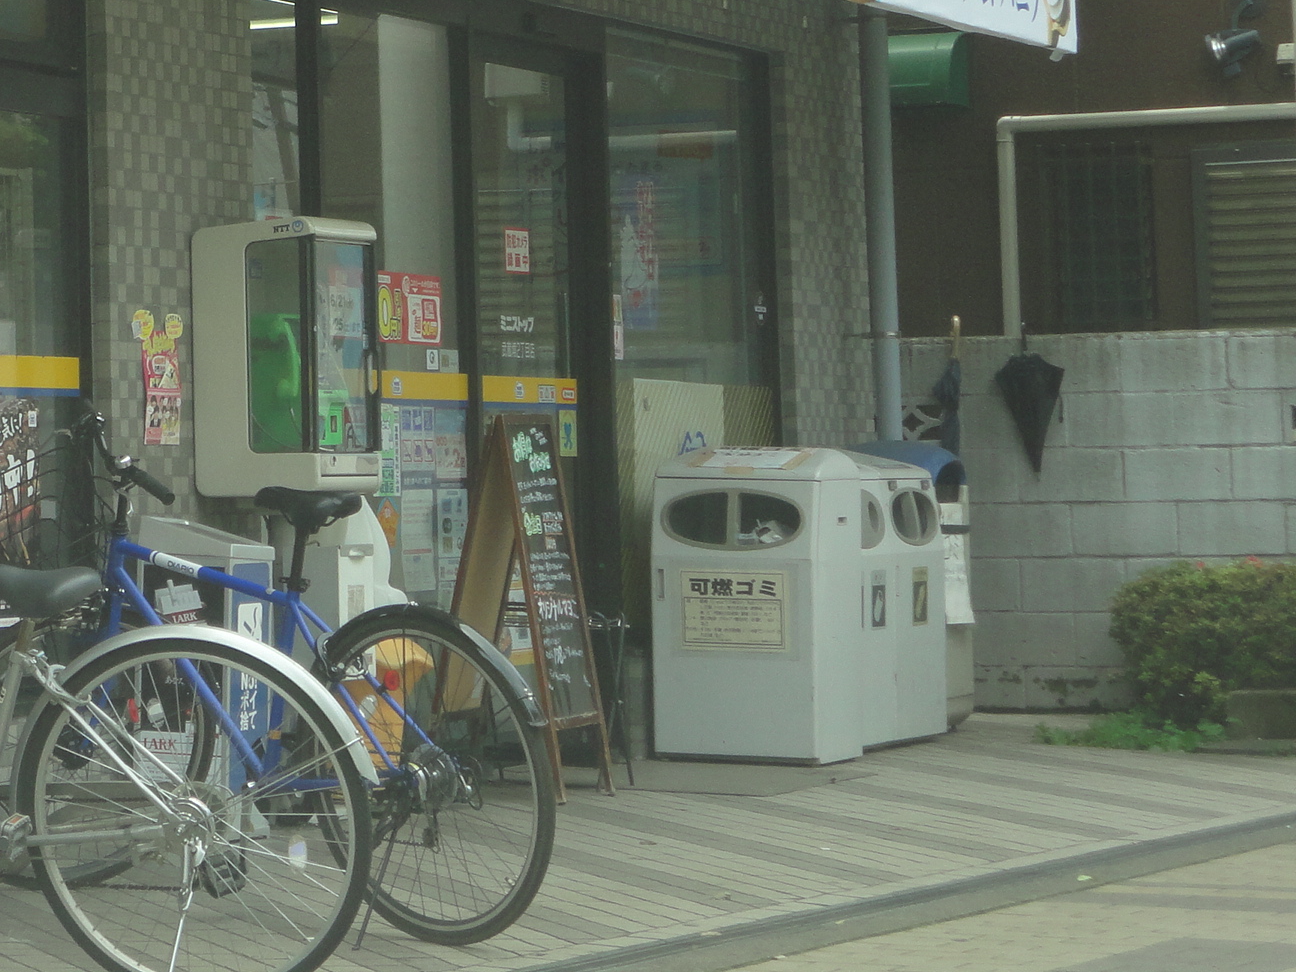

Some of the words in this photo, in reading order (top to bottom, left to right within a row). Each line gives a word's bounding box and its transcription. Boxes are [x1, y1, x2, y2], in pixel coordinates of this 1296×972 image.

[273, 224, 290, 233] NTT
[500, 315, 534, 332] ミニストップ
[167, 560, 195, 575] DIARIO
[689, 578, 776, 597] 可燃ゴミ
[172, 611, 198, 624] LARK
